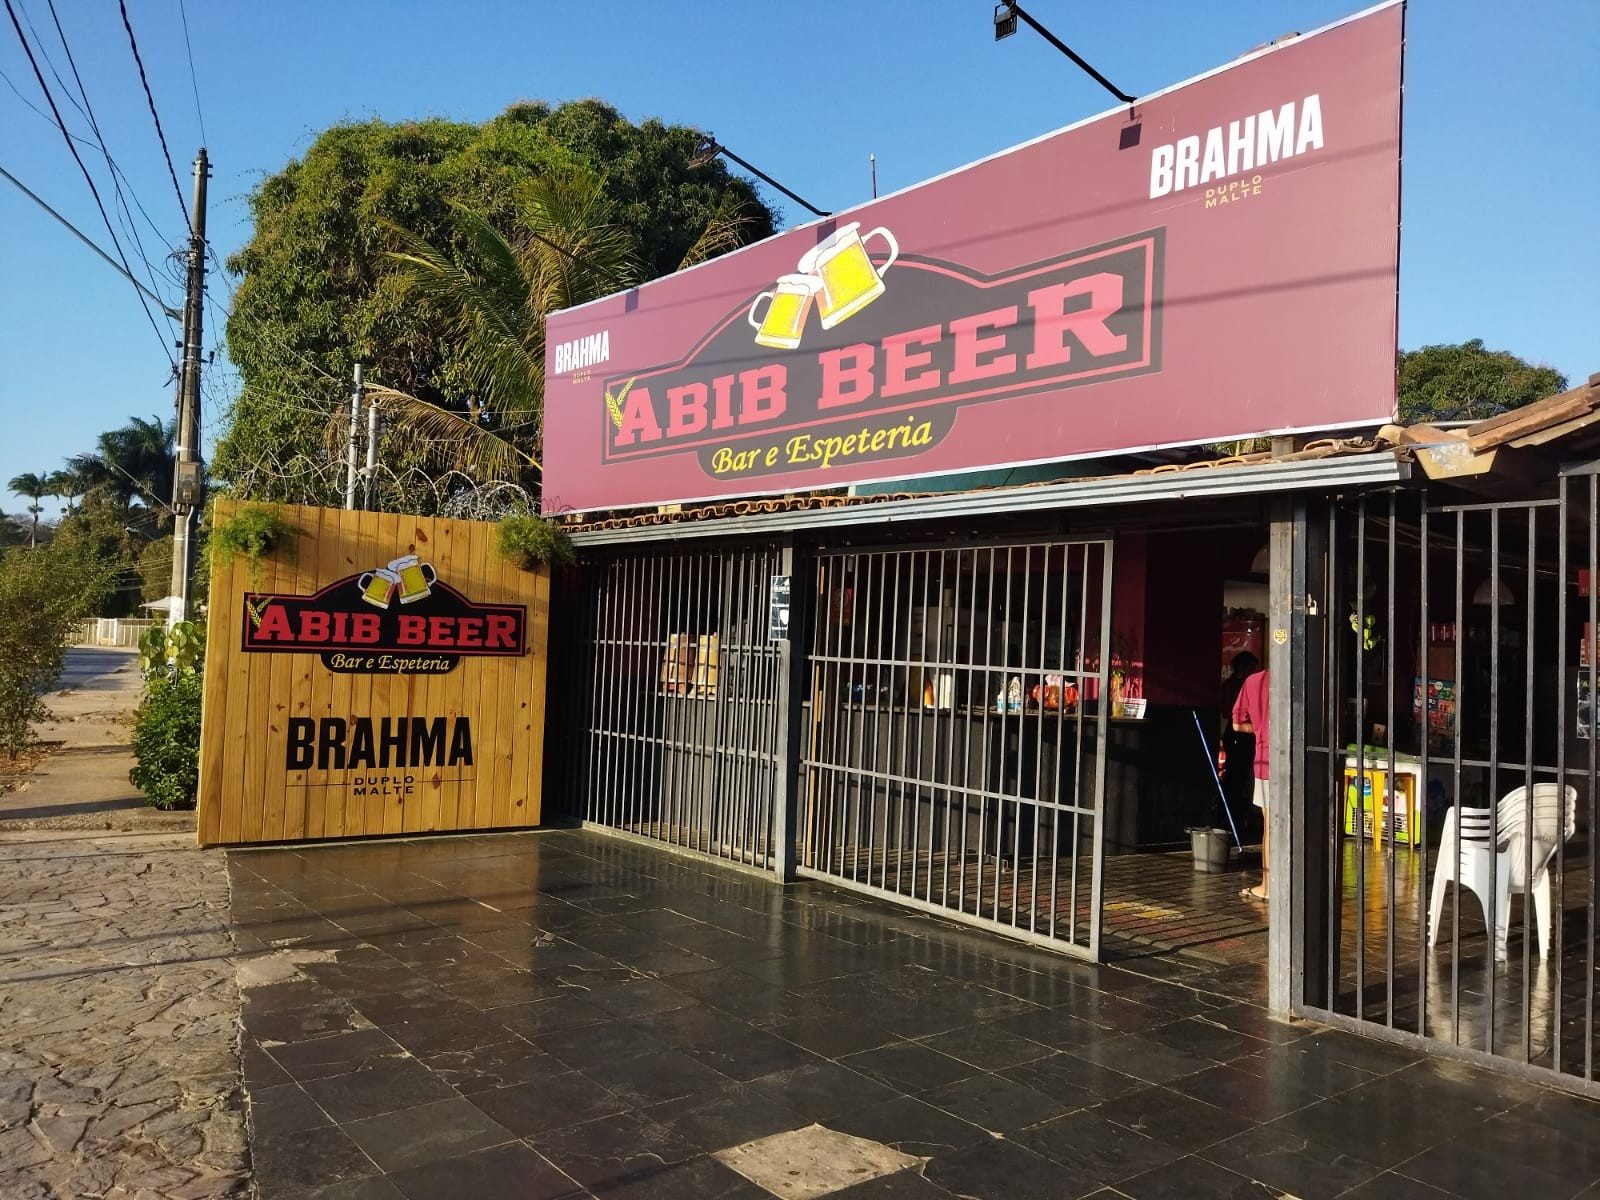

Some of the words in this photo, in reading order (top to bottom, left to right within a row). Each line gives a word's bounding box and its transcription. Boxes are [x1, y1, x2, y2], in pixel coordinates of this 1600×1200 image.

[1150, 93, 1324, 200] BRAHMA
[1205, 175, 1262, 199] DUPLO
[1205, 185, 1262, 209] MALTE
[555, 330, 610, 375] BRAHMA
[613, 363, 788, 446] ABIB
[817, 272, 1127, 410] BEER
[712, 447, 761, 474] Bar
[765, 446, 779, 467] e
[786, 415, 933, 469] Espeteria
[254, 605, 380, 645] ABIB
[397, 614, 517, 648] BEER
[331, 653, 364, 669] Bar
[366, 659, 375, 669] e
[378, 655, 450, 674] Espeteria
[286, 717, 474, 771] BRAHMA
[354, 775, 415, 786] DUPLO
[354, 785, 415, 796] MALTE
